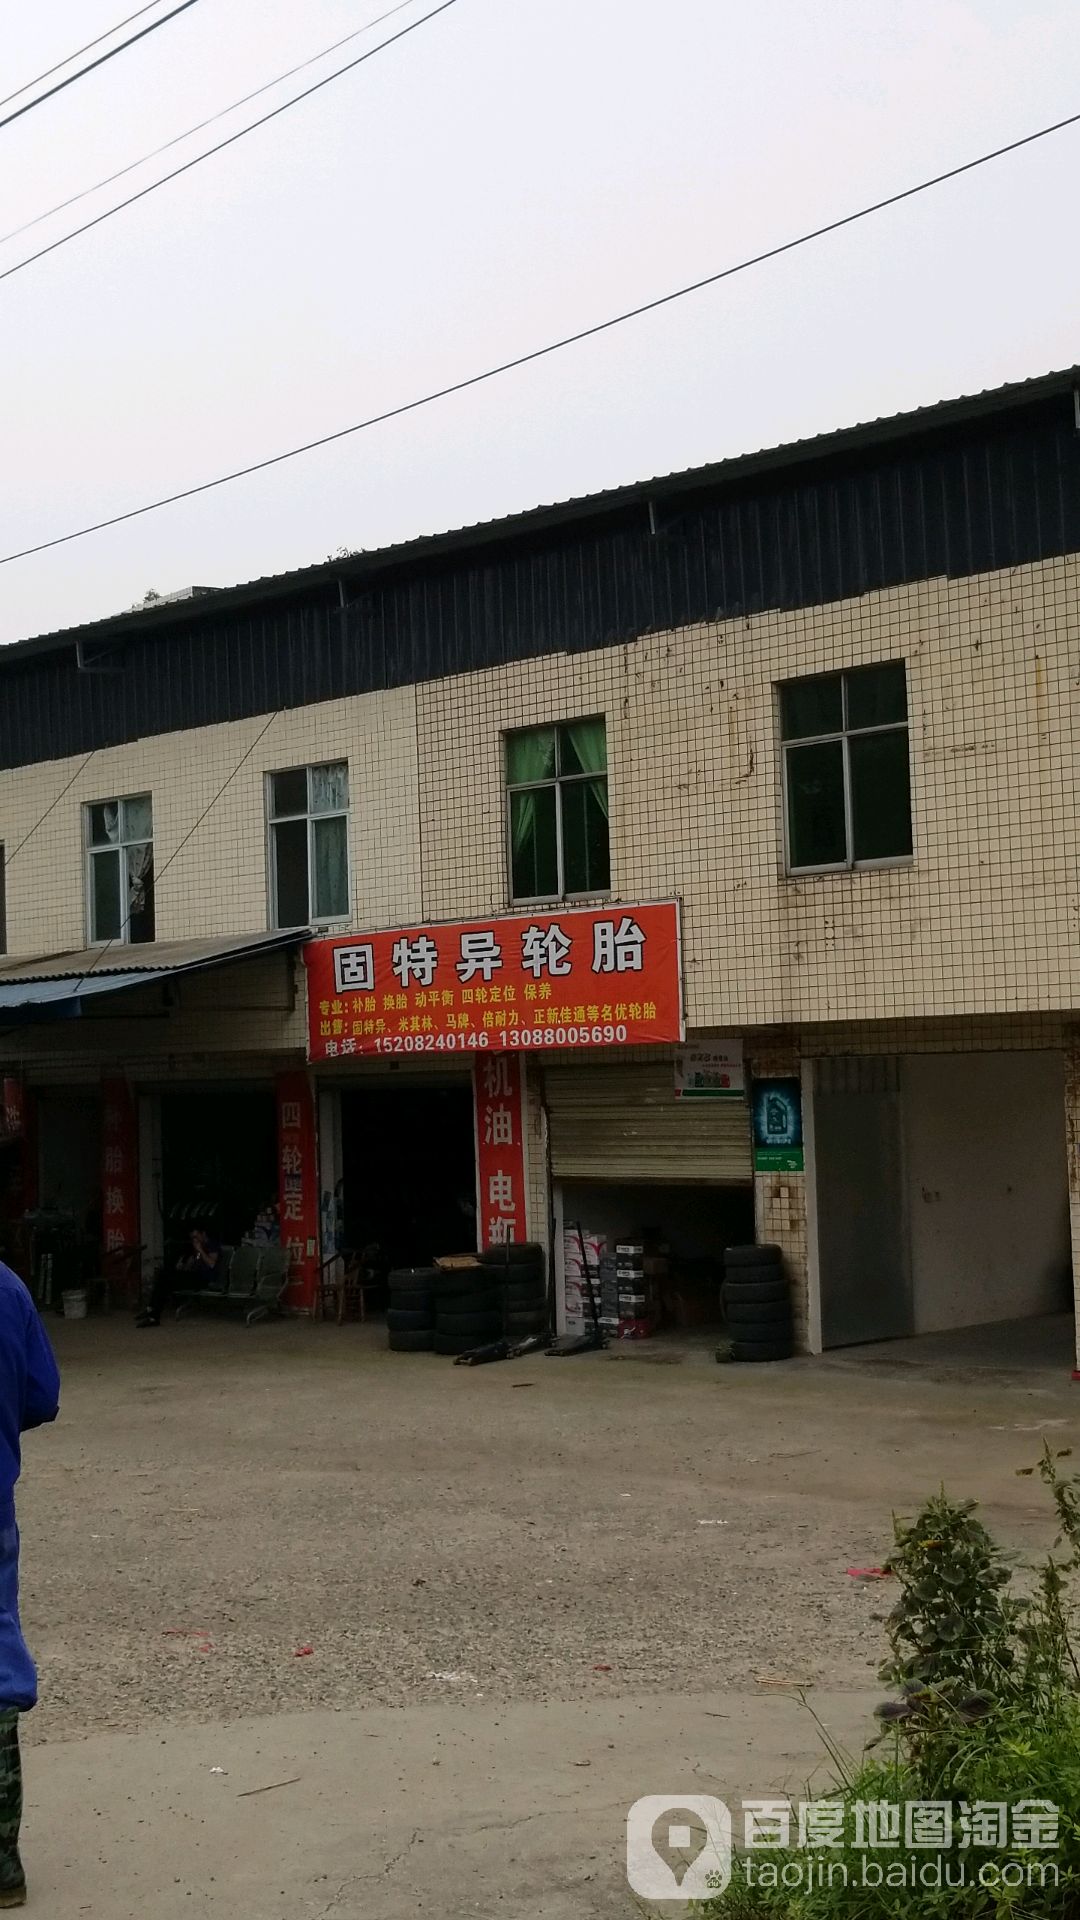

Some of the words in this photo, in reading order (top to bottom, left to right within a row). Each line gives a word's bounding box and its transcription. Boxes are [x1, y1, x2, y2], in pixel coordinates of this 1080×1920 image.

[332, 916, 646, 993] 固特异轮胎
[383, 993, 408, 1011] 换胎
[415, 990, 454, 1008] 动平衡
[461, 985, 516, 1005] 四轮定位
[524, 982, 552, 1001] 保养
[373, 1031, 489, 1053] 15208240146
[499, 1024, 627, 1047] 13088005690
